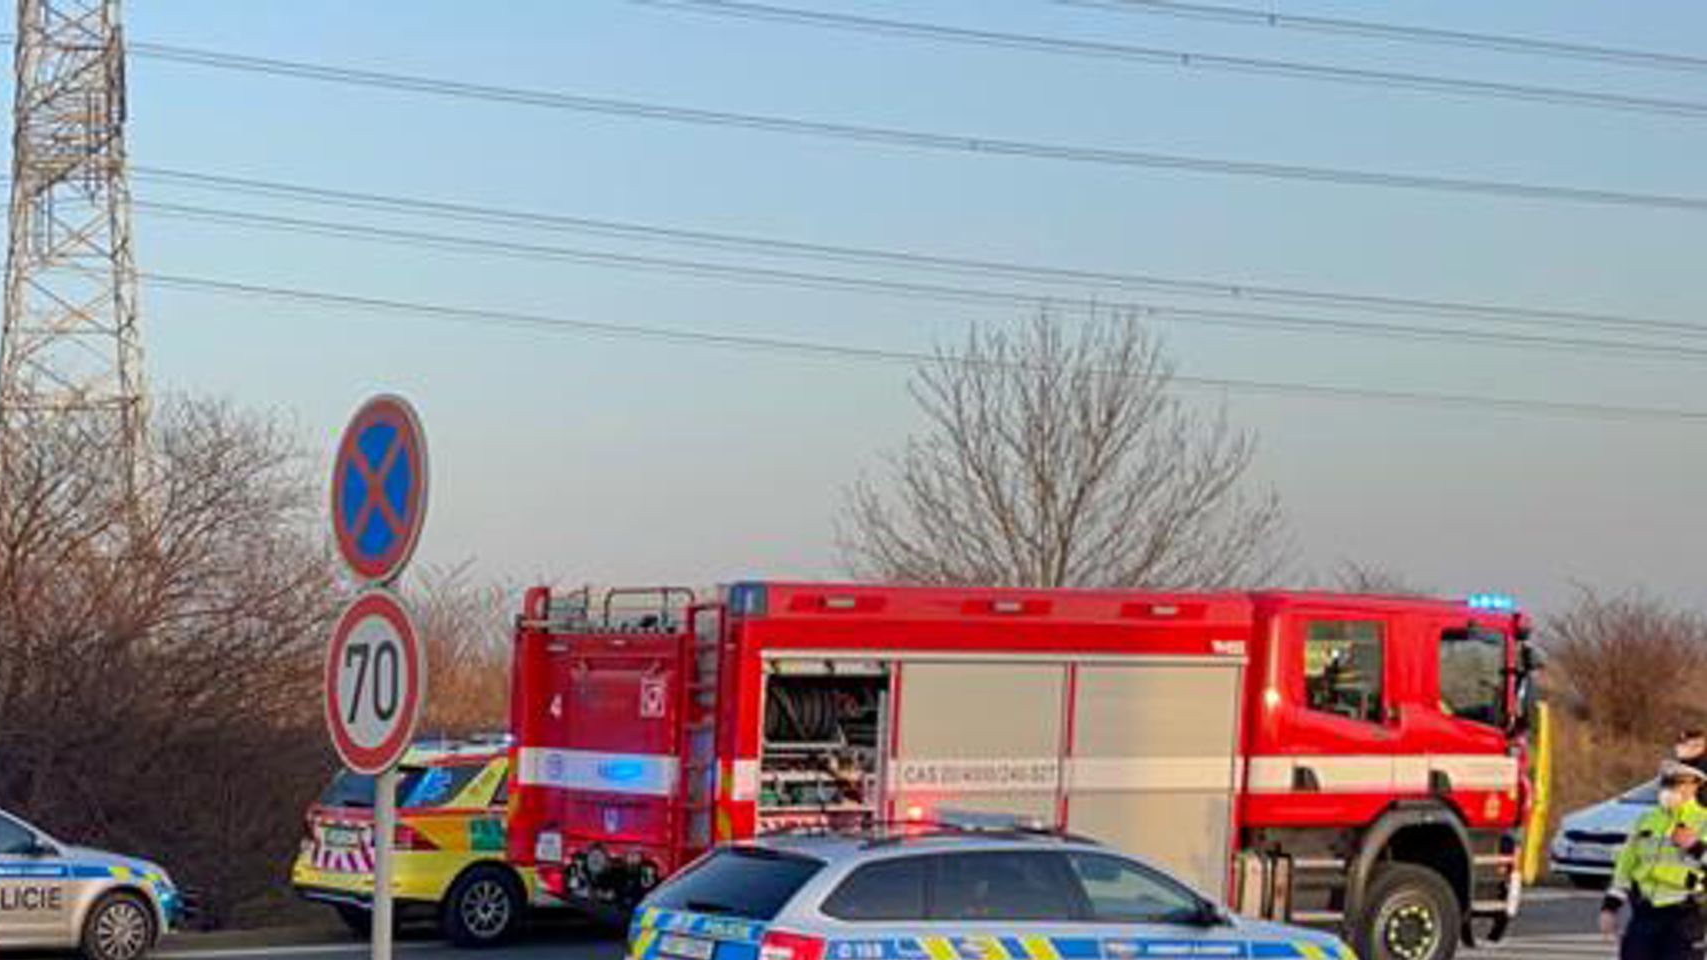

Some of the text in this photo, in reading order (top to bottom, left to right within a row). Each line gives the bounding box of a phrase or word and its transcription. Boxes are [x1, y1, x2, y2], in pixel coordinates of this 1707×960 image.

[345, 640, 399, 724] 70
[550, 693, 563, 718] 4
[904, 764, 937, 783] CAS
